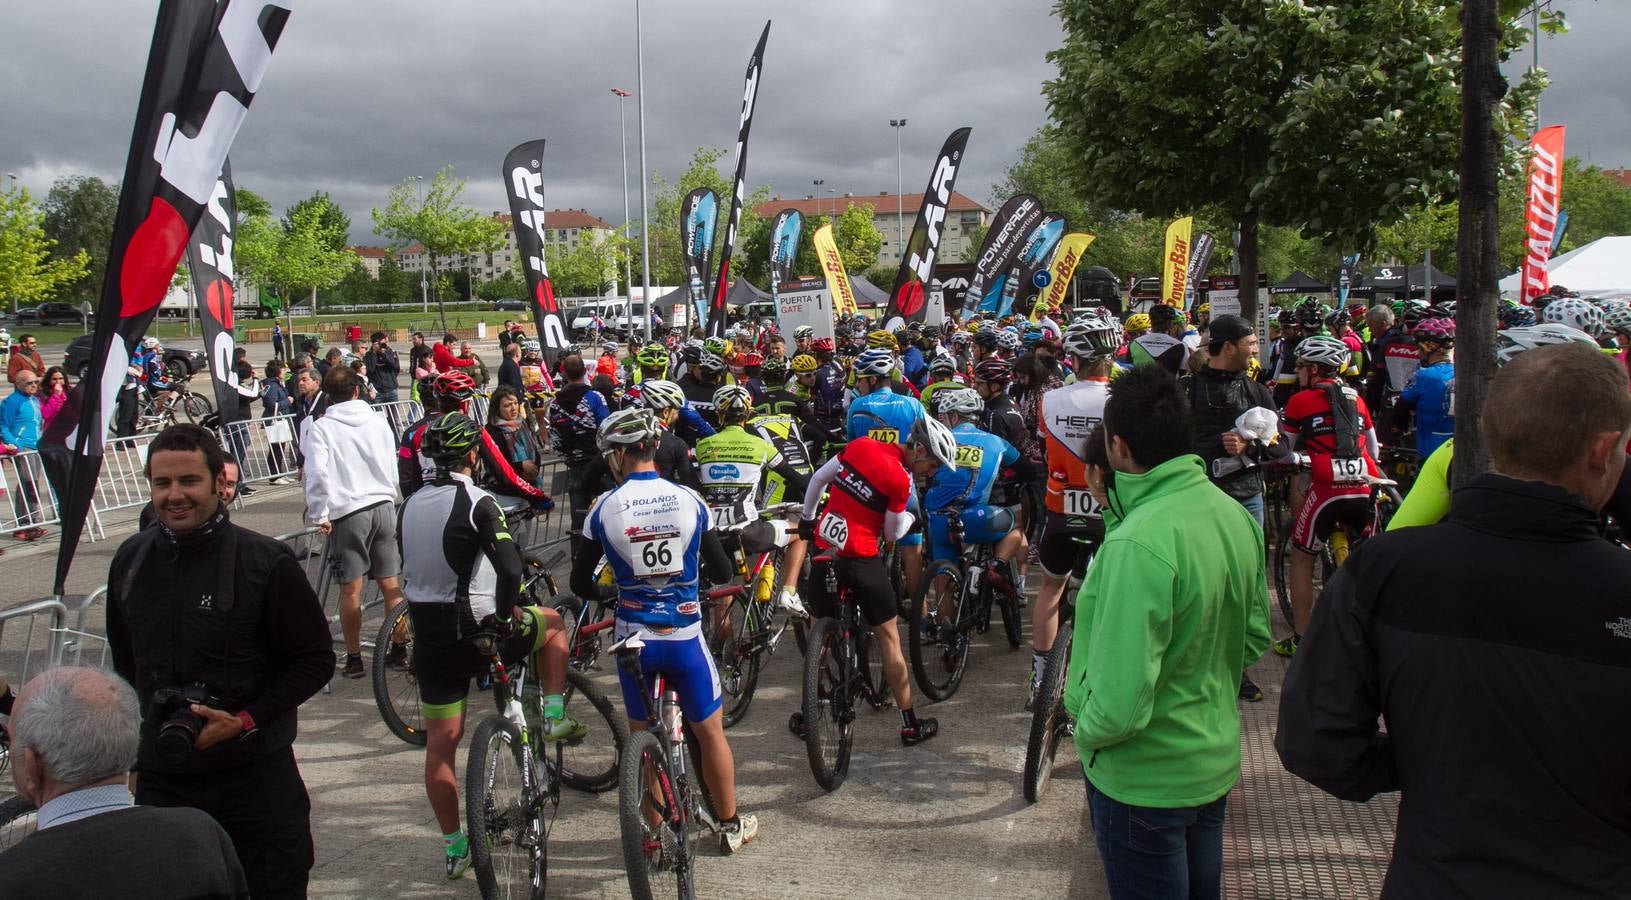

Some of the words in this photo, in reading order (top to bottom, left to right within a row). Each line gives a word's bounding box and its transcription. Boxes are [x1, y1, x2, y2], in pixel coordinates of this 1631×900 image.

[977, 198, 1035, 272] POWERADE
[1017, 215, 1053, 261] POWERADE
[986, 256, 1004, 279] bebida
[1002, 239, 1014, 258] para
[1011, 209, 1041, 243] deportistas
[780, 295, 812, 305] PUERTA
[815, 294, 822, 310] 1
[934, 294, 940, 305] 2
[781, 305, 802, 313] GATE
[869, 431, 897, 444] 442
[632, 494, 677, 505] BOLAÑOS
[653, 507, 680, 515] Bolaños
[822, 515, 847, 544] 166
[642, 540, 673, 568] 66
